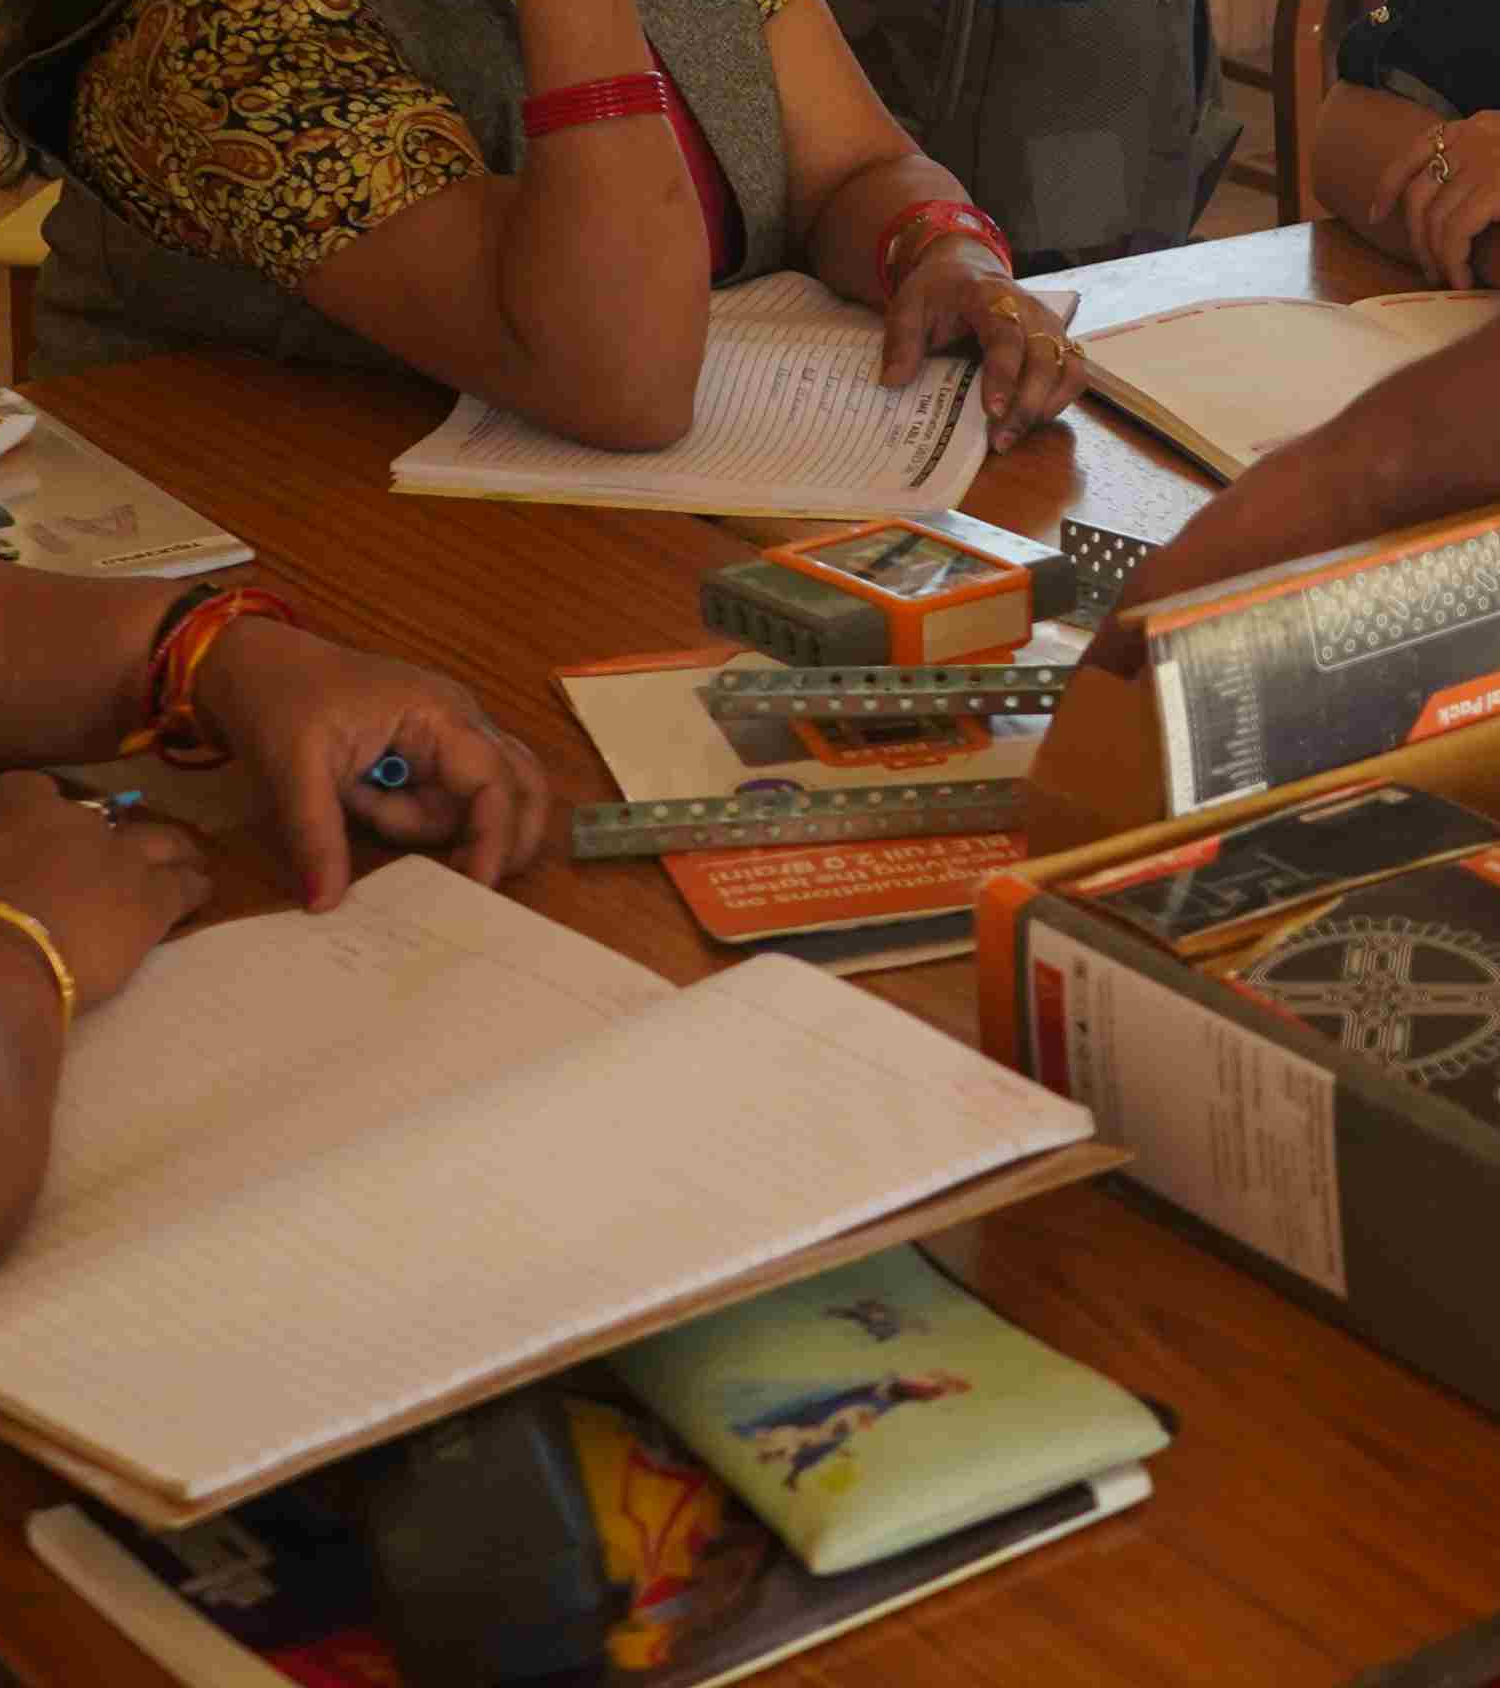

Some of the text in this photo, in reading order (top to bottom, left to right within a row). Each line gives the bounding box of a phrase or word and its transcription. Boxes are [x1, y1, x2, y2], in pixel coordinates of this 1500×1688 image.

[1436, 696, 1484, 725] Pack
[773, 865, 1004, 904] ongratulations
[817, 869, 869, 885] the
